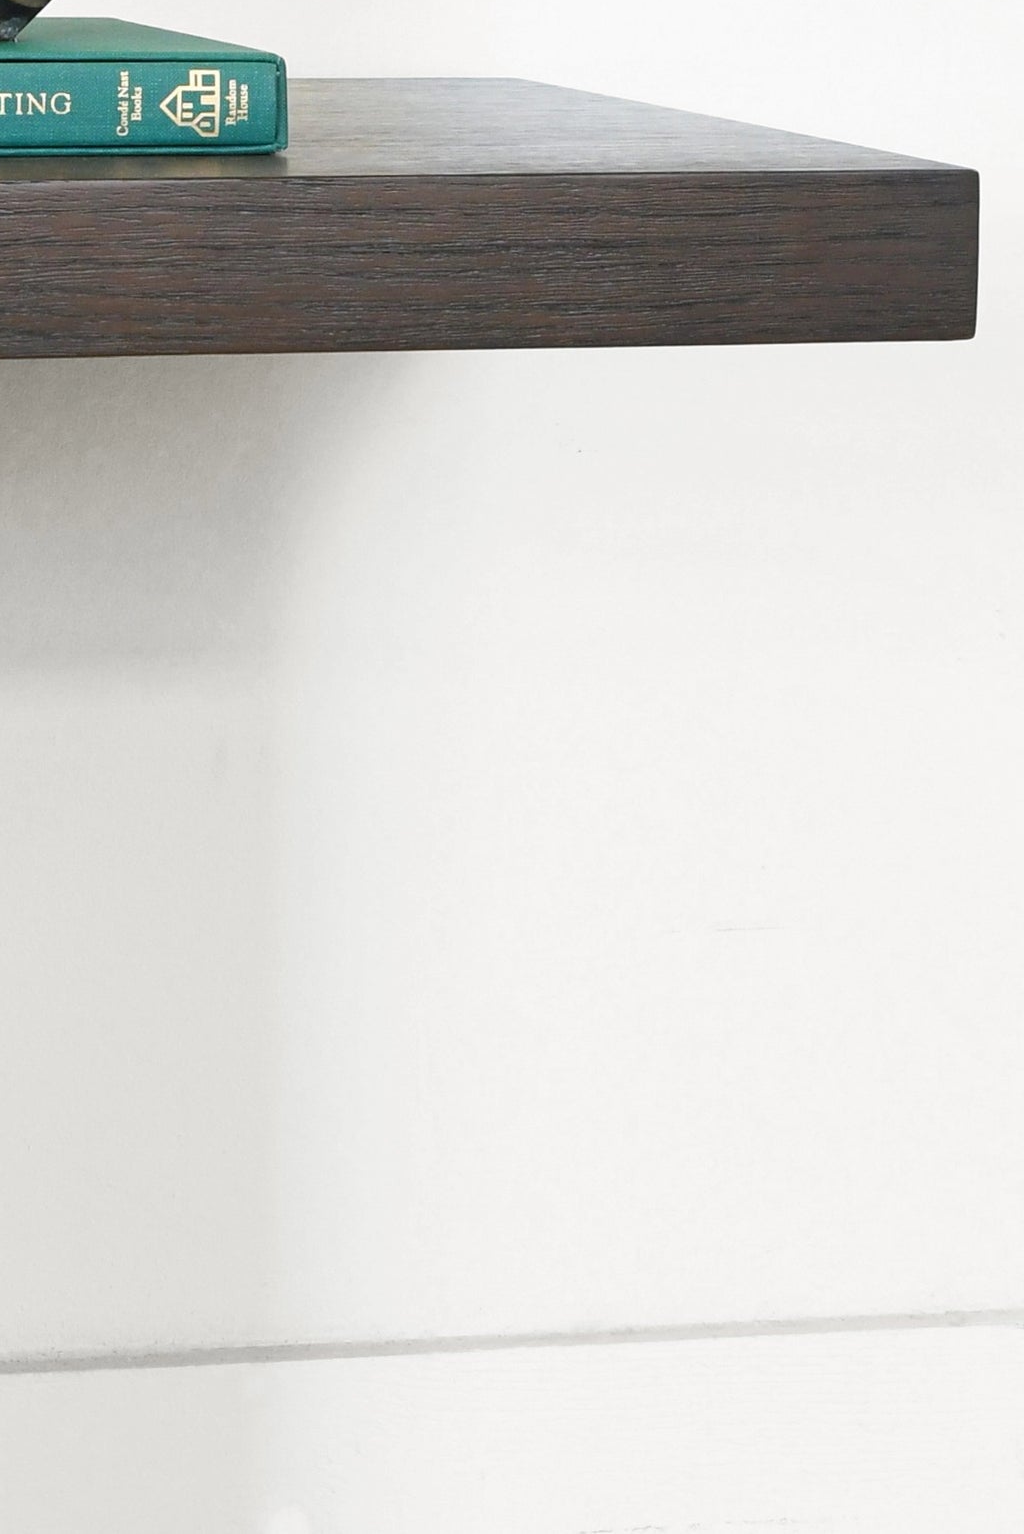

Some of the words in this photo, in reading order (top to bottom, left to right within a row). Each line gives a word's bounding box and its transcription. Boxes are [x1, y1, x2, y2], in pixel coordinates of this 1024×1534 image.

[117, 70, 129, 98] Nast
[236, 83, 249, 122] House
[130, 86, 142, 121] Books
[224, 79, 237, 127] Random
